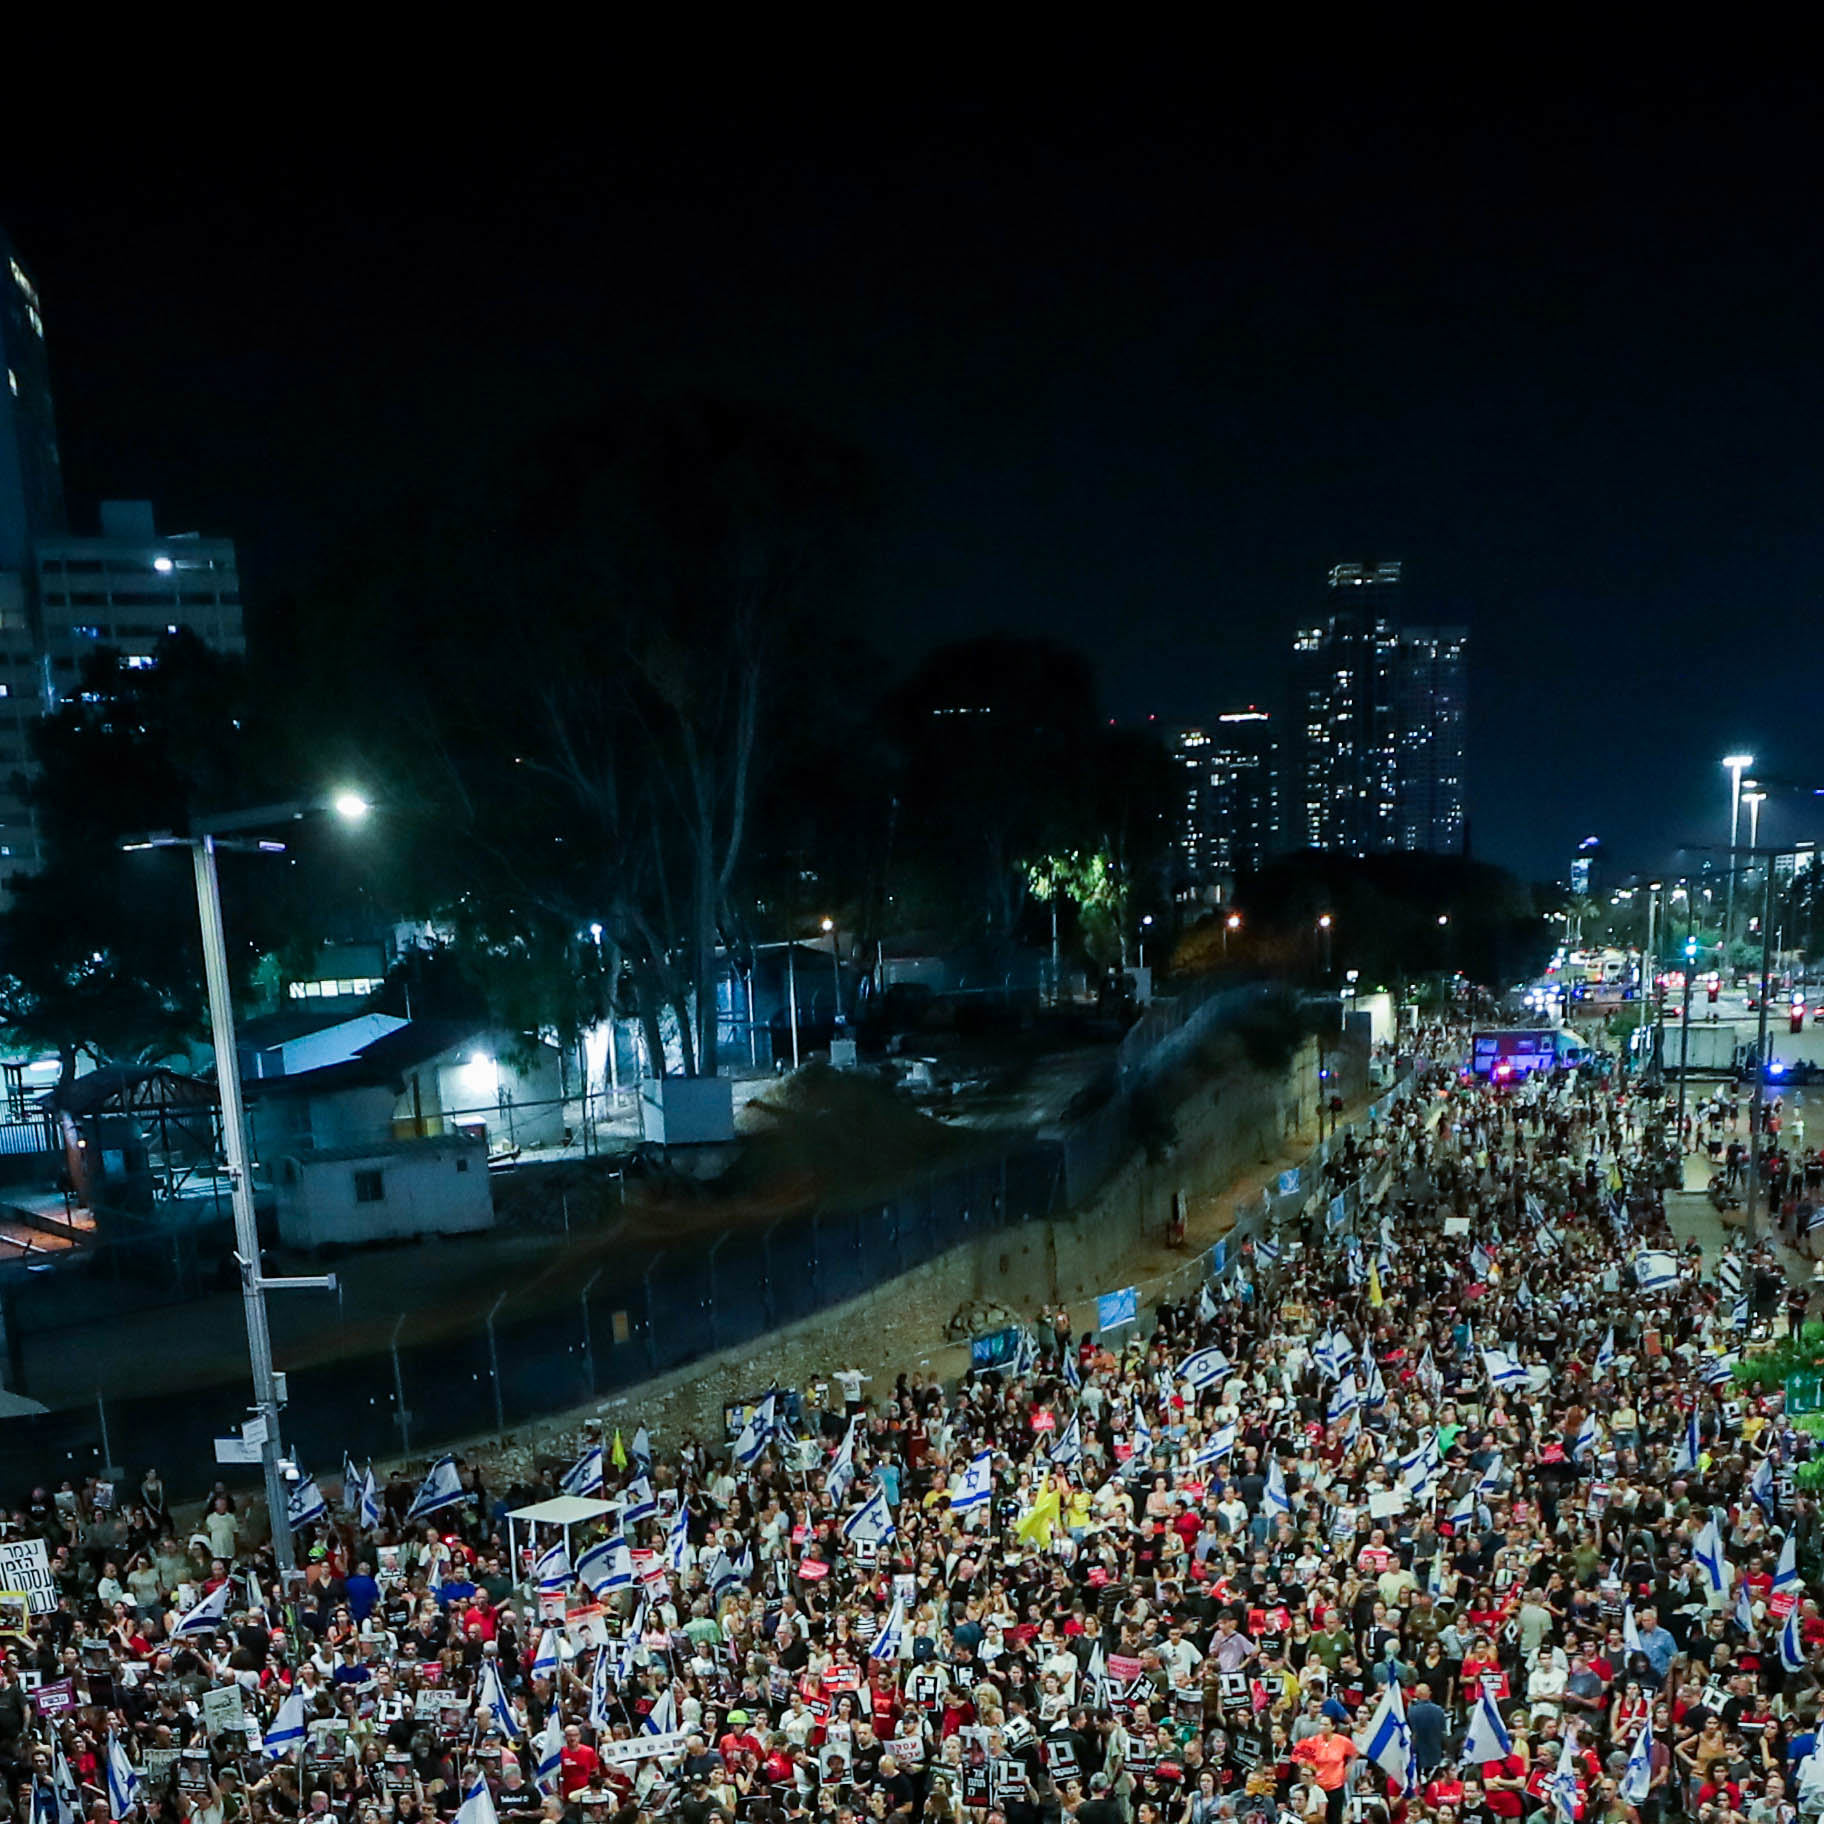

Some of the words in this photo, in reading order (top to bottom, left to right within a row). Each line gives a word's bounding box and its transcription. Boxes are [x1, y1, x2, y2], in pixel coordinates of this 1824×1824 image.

[4, 1546, 38, 1558] נגמר
[856, 1540, 876, 1558] כן
[11, 1568, 53, 1593] עסקה
[1220, 1671, 1249, 1695] כן
[1047, 1742, 1075, 1768] כן
[1124, 1734, 1146, 1761] כן
[996, 1760, 1026, 1784] כן
